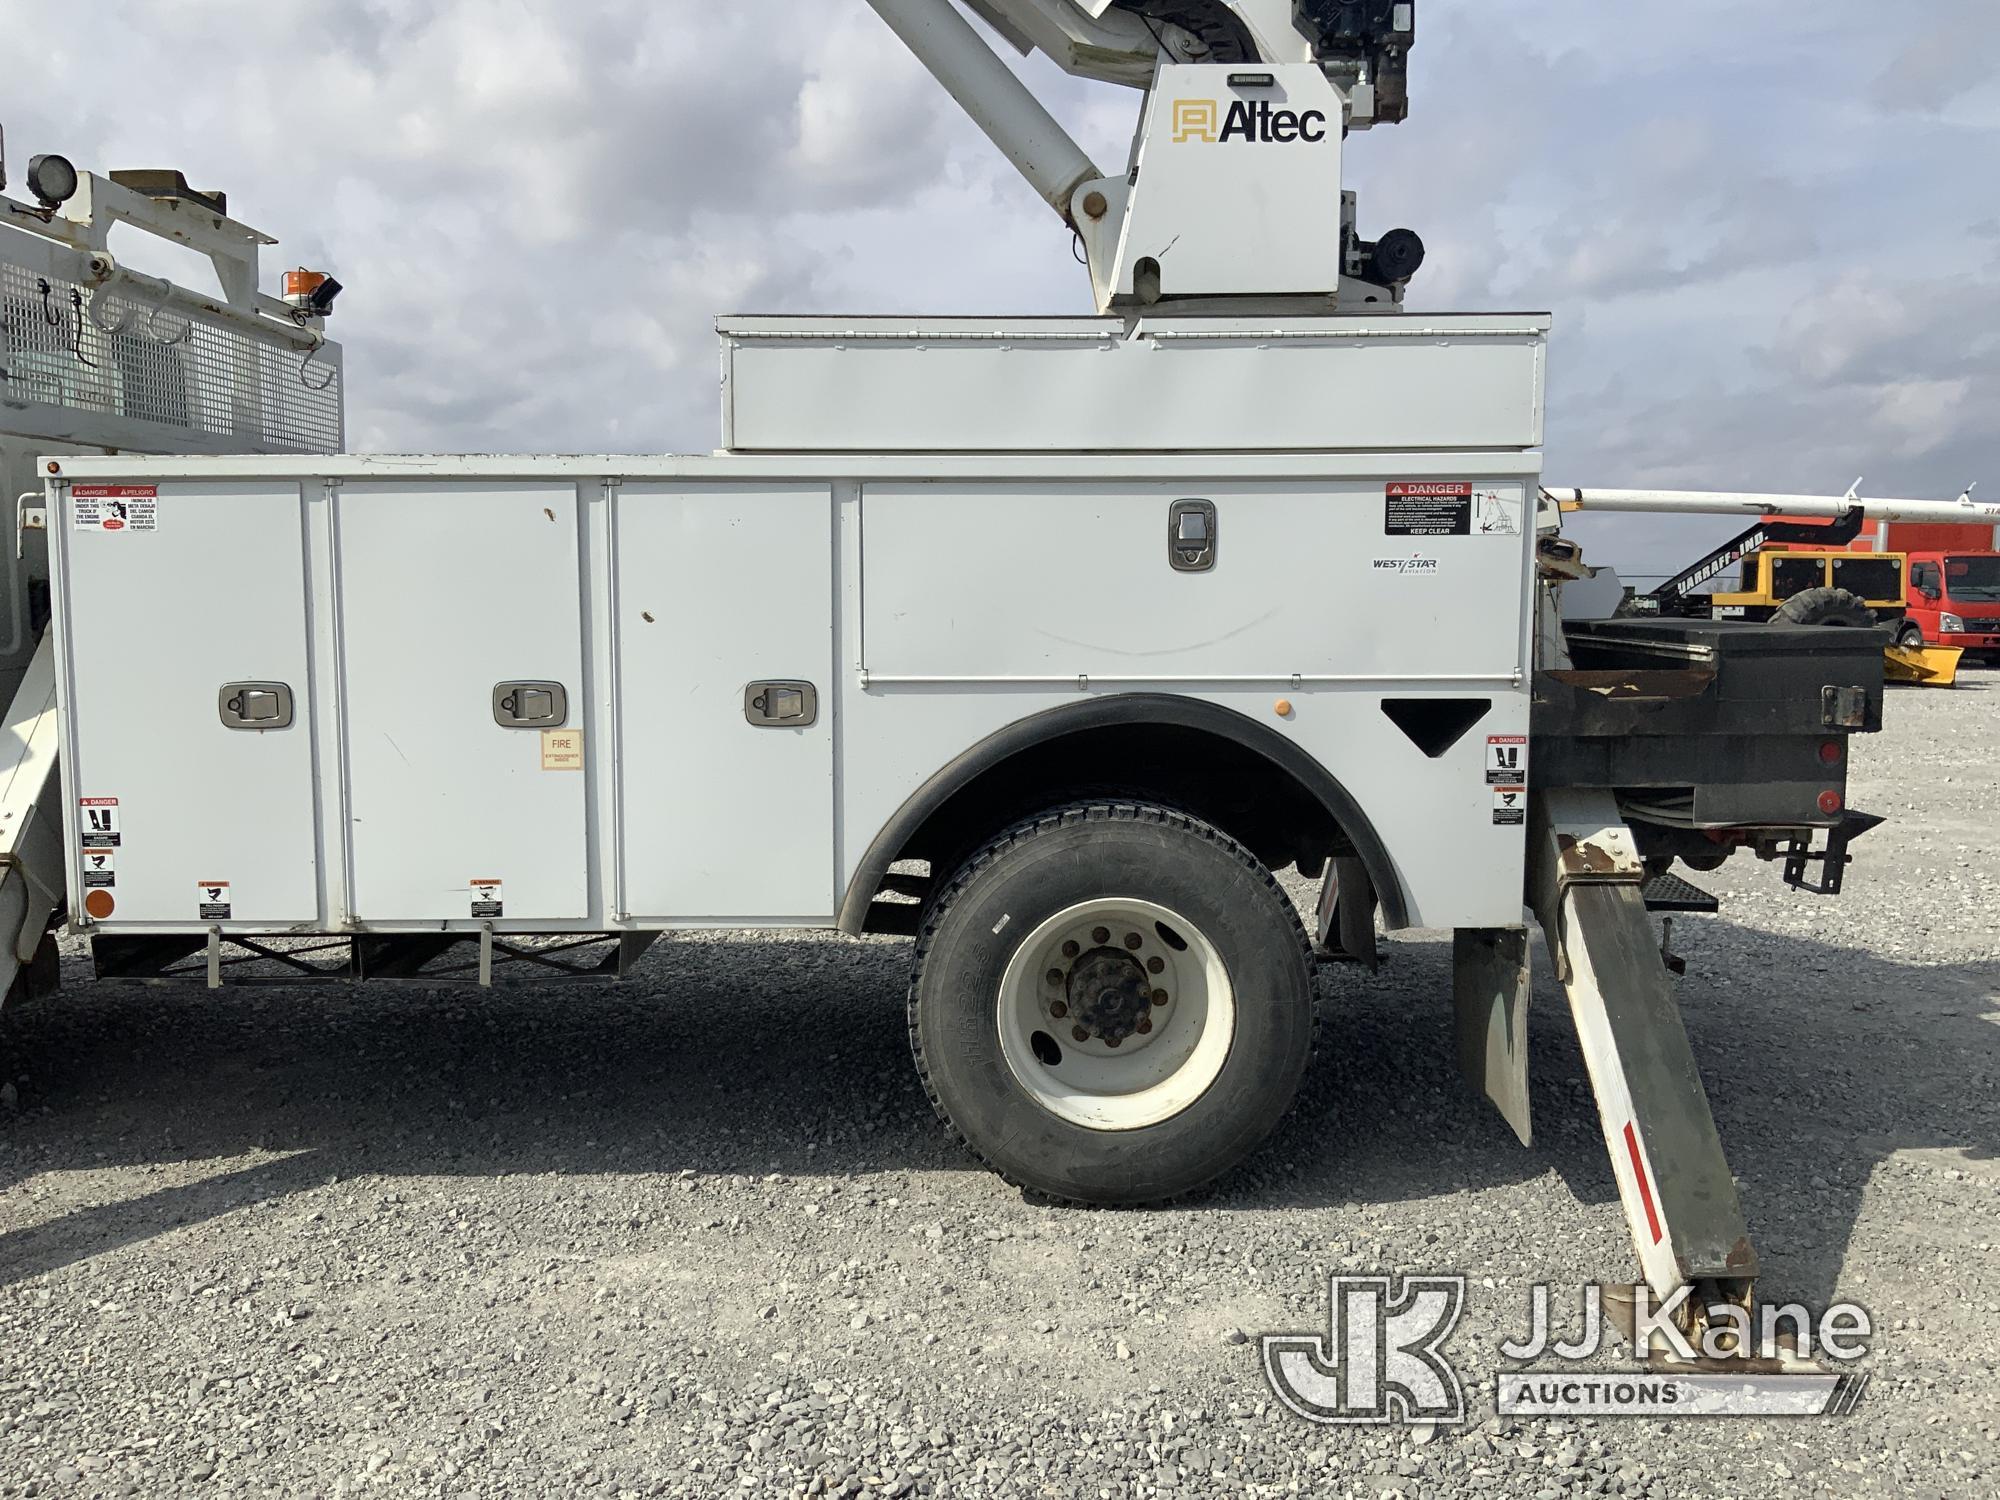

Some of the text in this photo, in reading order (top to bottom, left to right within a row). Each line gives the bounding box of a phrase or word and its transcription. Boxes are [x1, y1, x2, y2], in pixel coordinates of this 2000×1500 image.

[1219, 101, 1326, 143] Altec
[1408, 485, 1464, 494] DANGER
[1373, 560, 1437, 568] WEST STAR
[552, 740, 571, 748] FIRE
